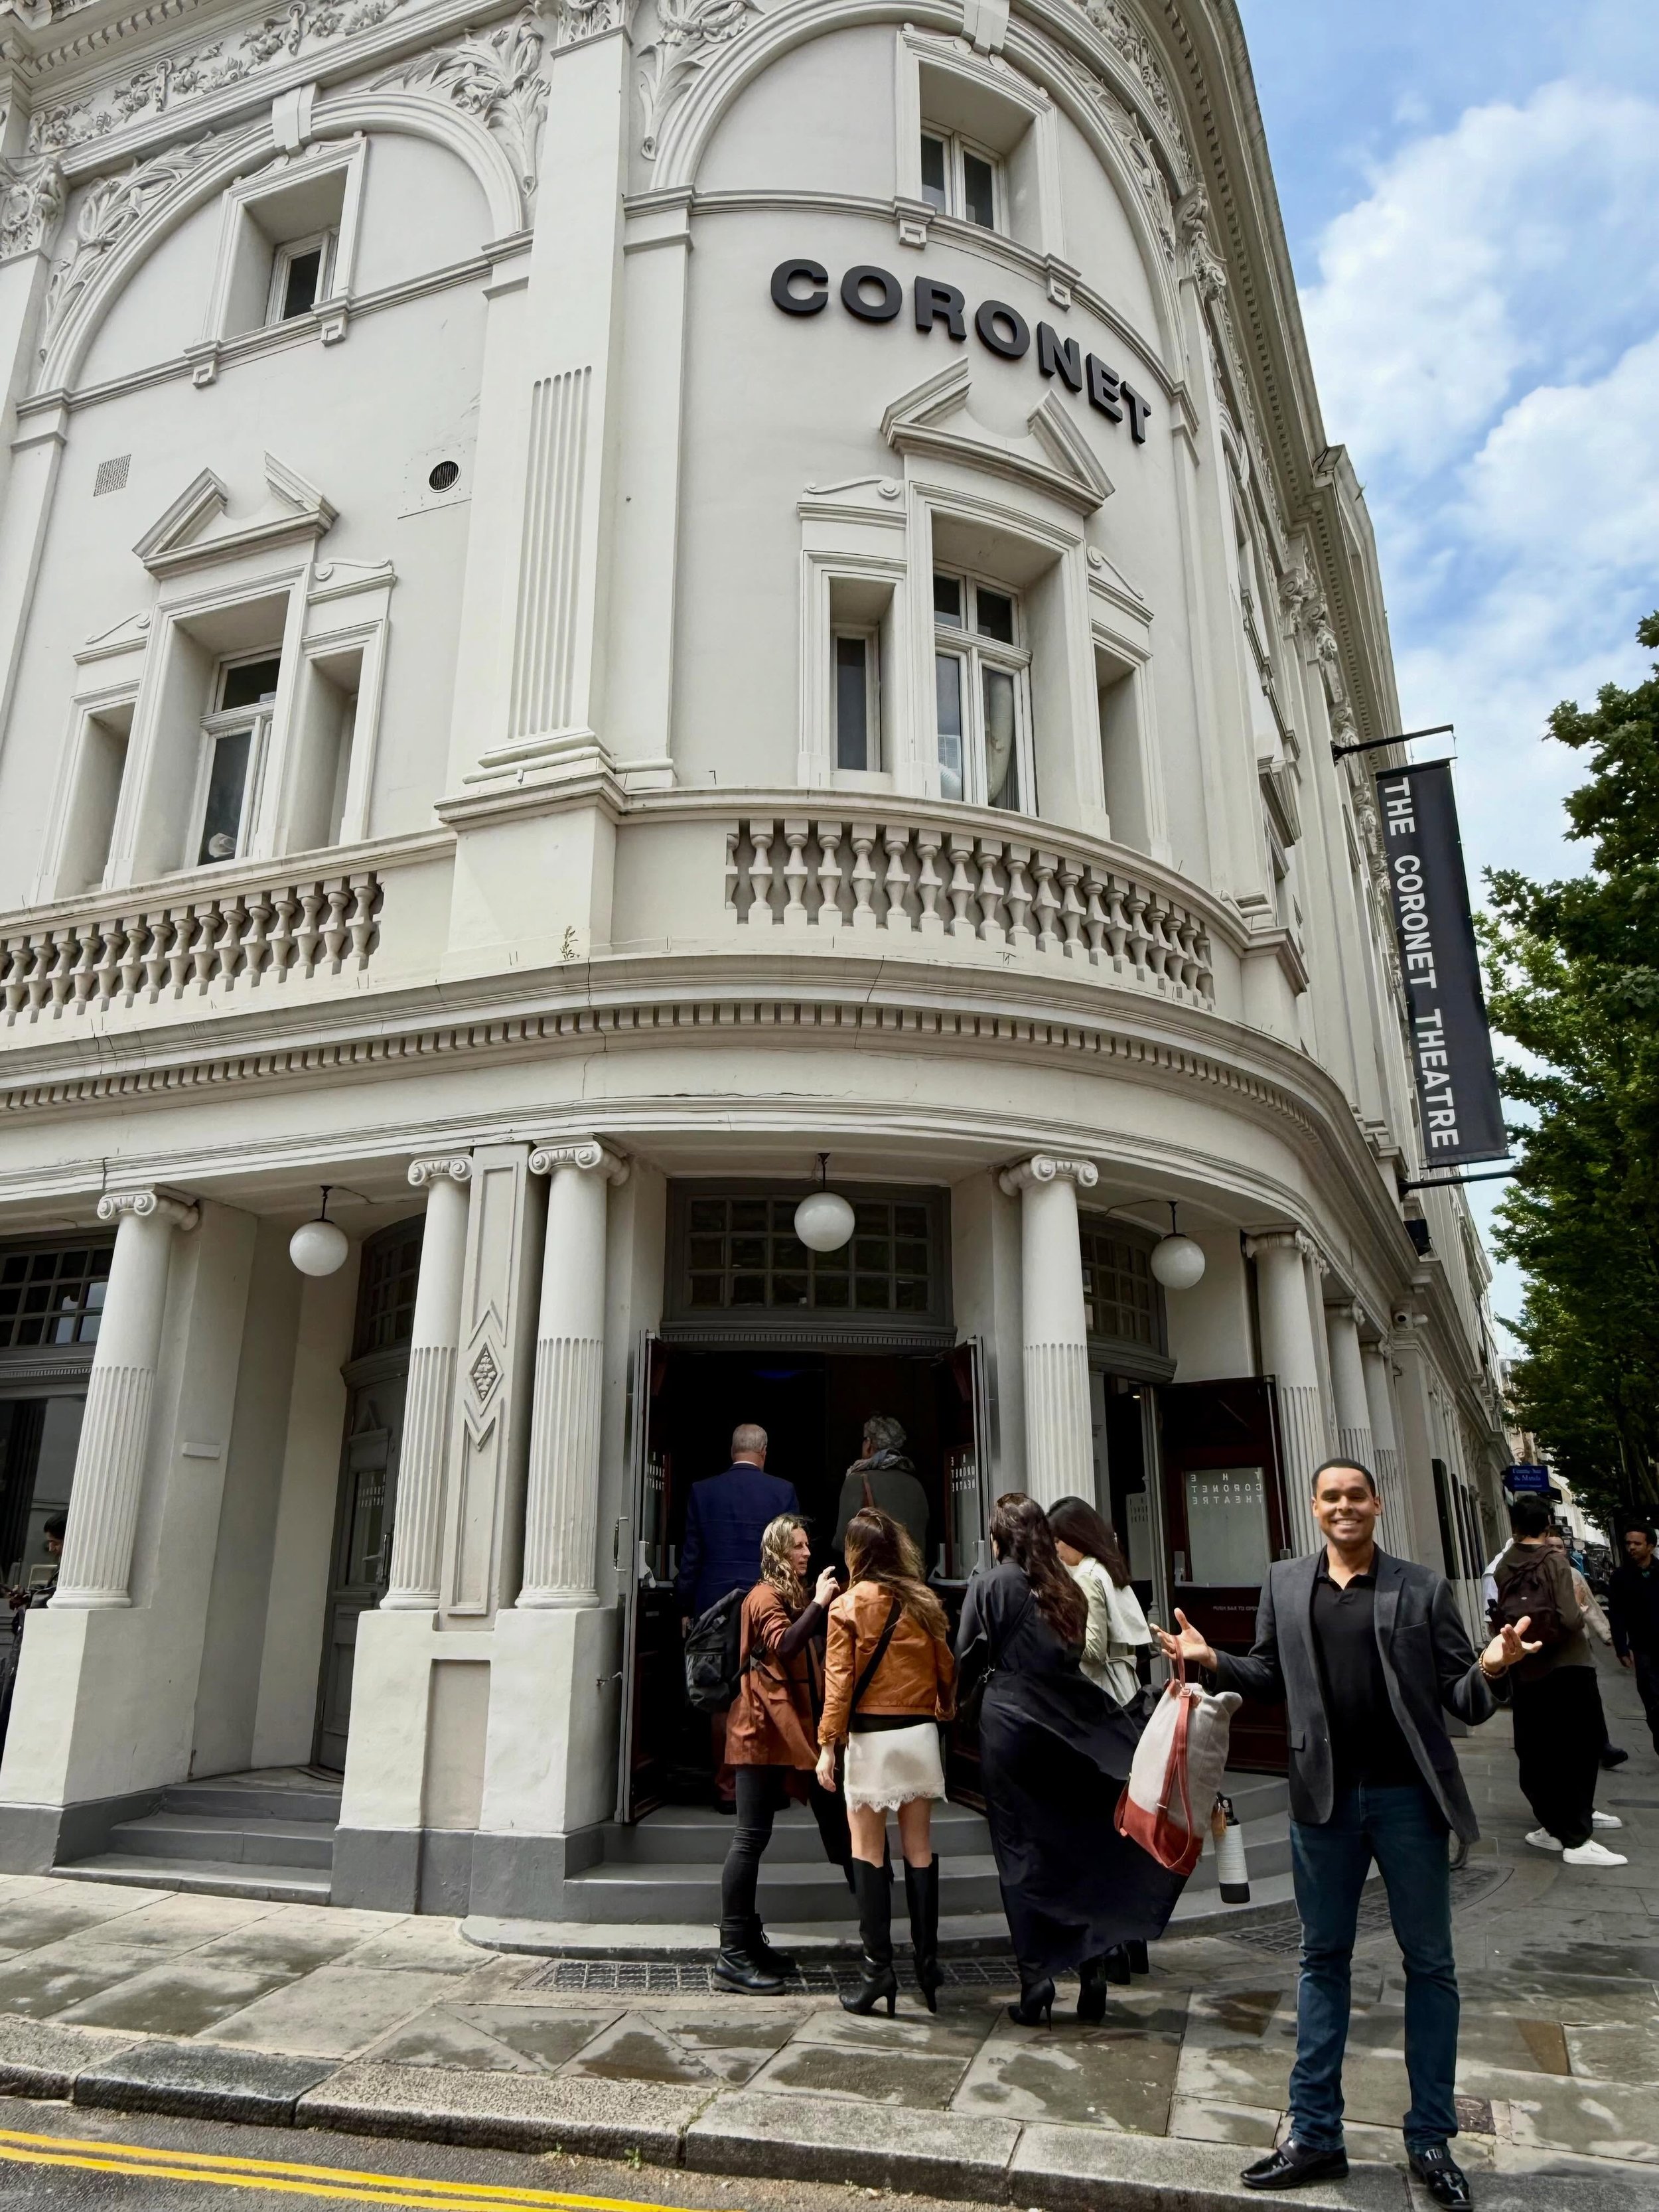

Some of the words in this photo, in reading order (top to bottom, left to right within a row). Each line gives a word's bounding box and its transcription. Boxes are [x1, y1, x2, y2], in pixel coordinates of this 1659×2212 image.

[770, 259, 1151, 444] CORONET
[1384, 776, 1415, 836] THE
[1394, 855, 1437, 989] CORONET
[1415, 1008, 1459, 1147] THEATRE
